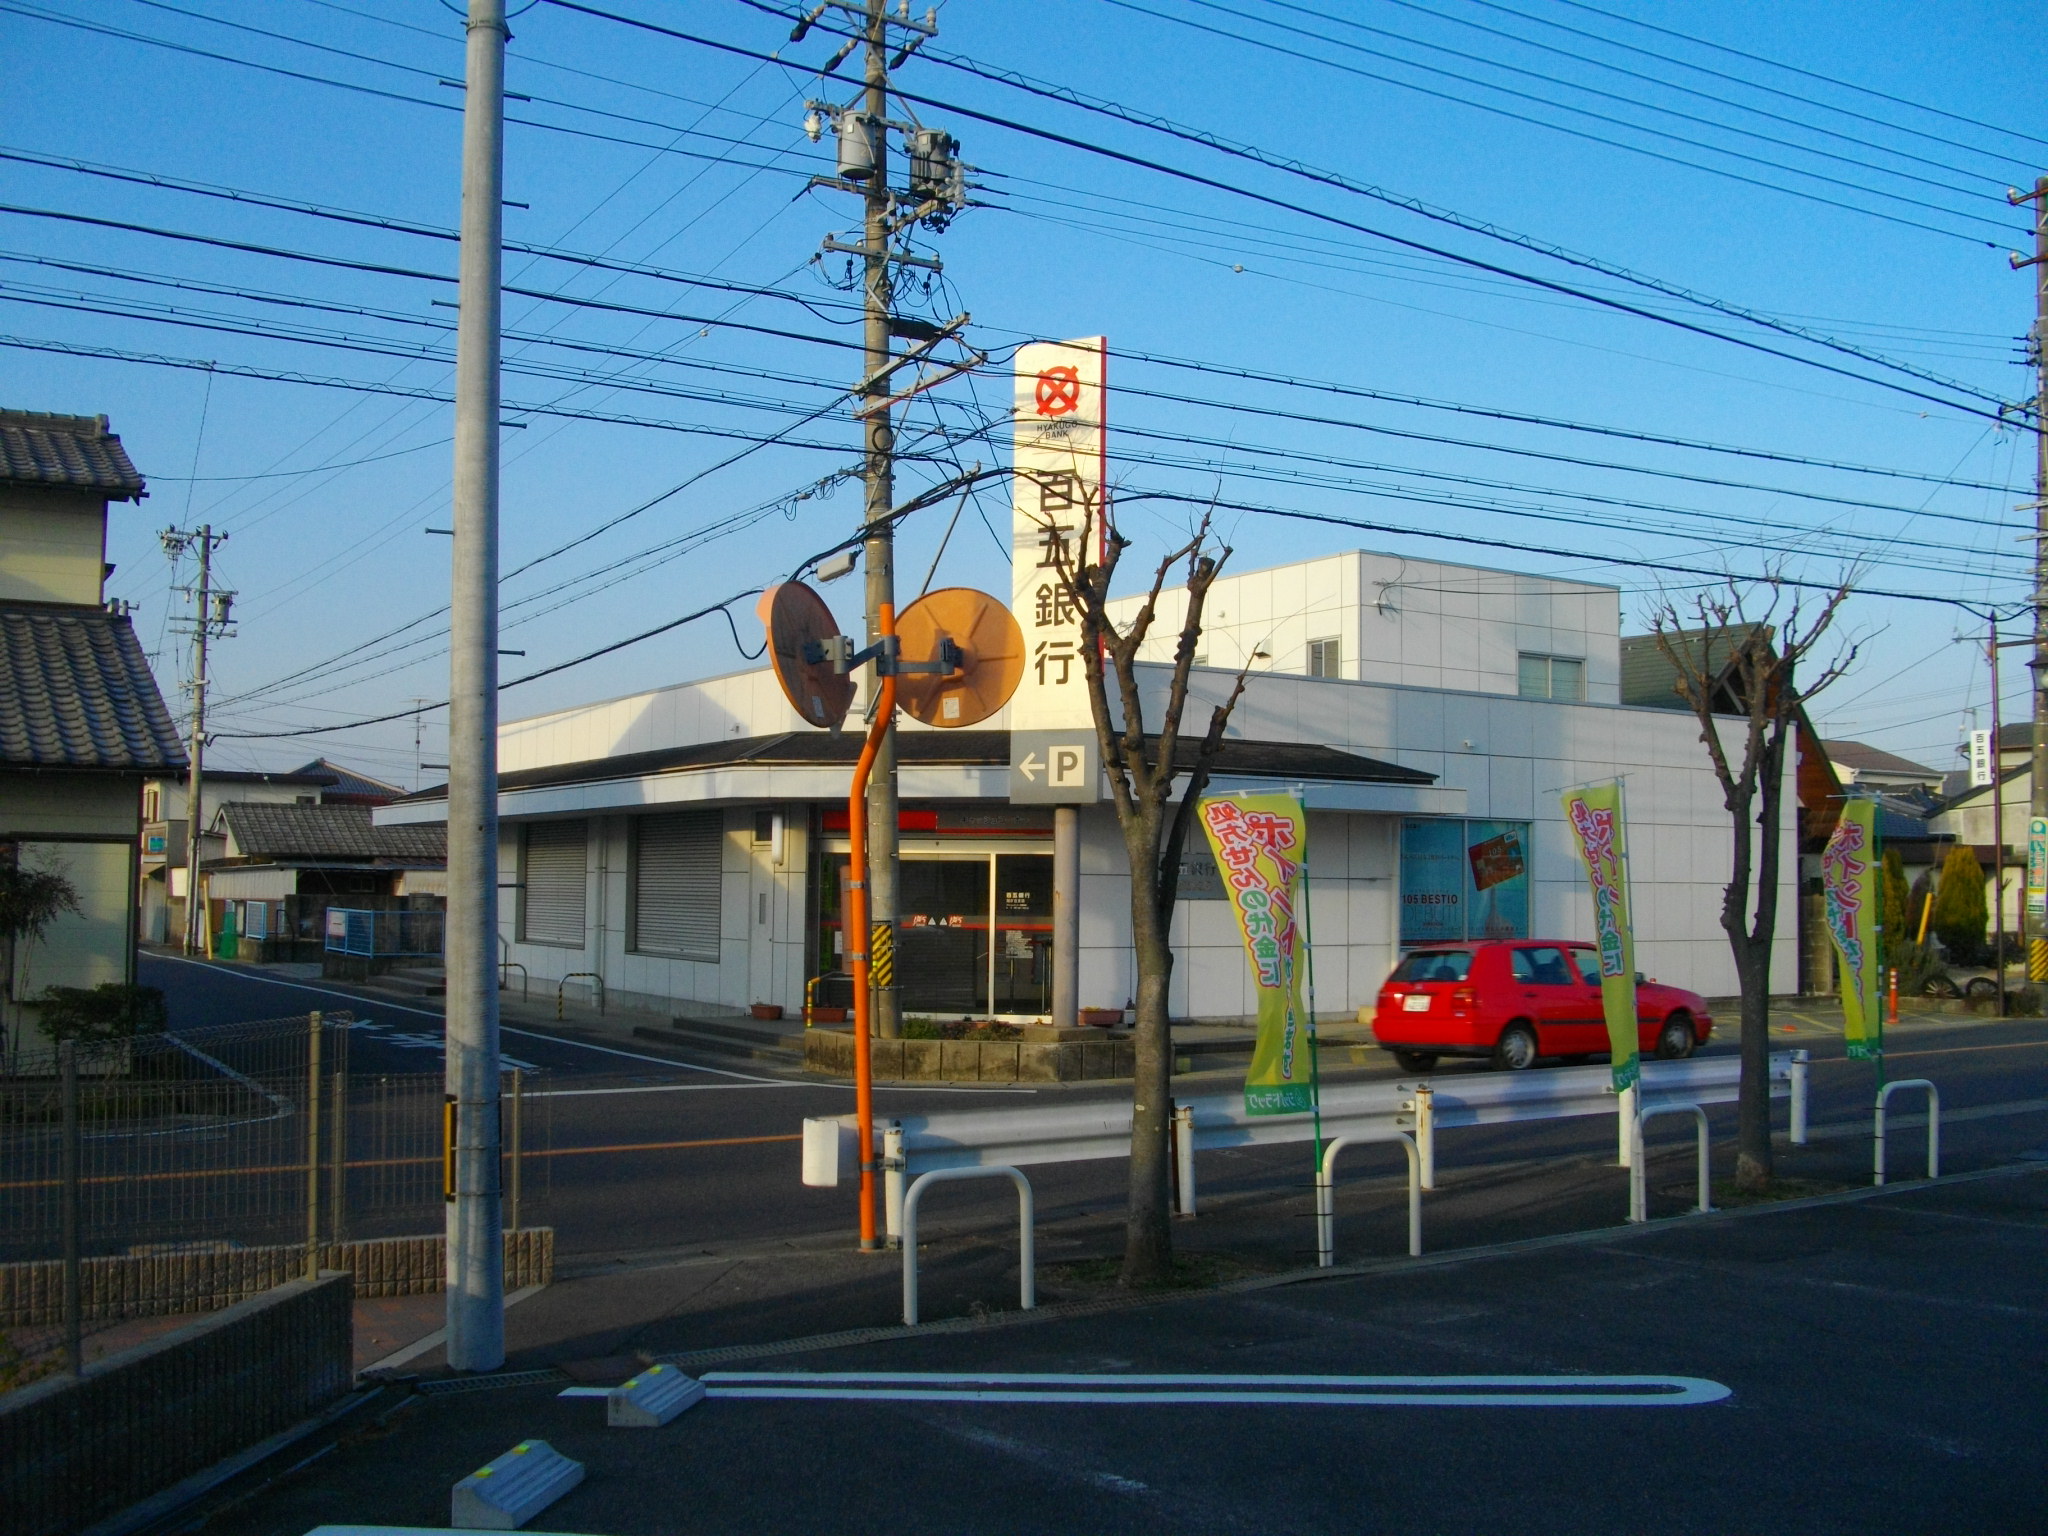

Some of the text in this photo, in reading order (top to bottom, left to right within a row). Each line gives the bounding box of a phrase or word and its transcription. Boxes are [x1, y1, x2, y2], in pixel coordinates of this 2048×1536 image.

[1036, 420, 1078, 432] HYAKUGO
[1045, 429, 1069, 439] BANK
[1035, 468, 1077, 686] 百五銀行
[1056, 750, 1078, 782] P
[1402, 894, 1458, 905] 105 BESTIO
